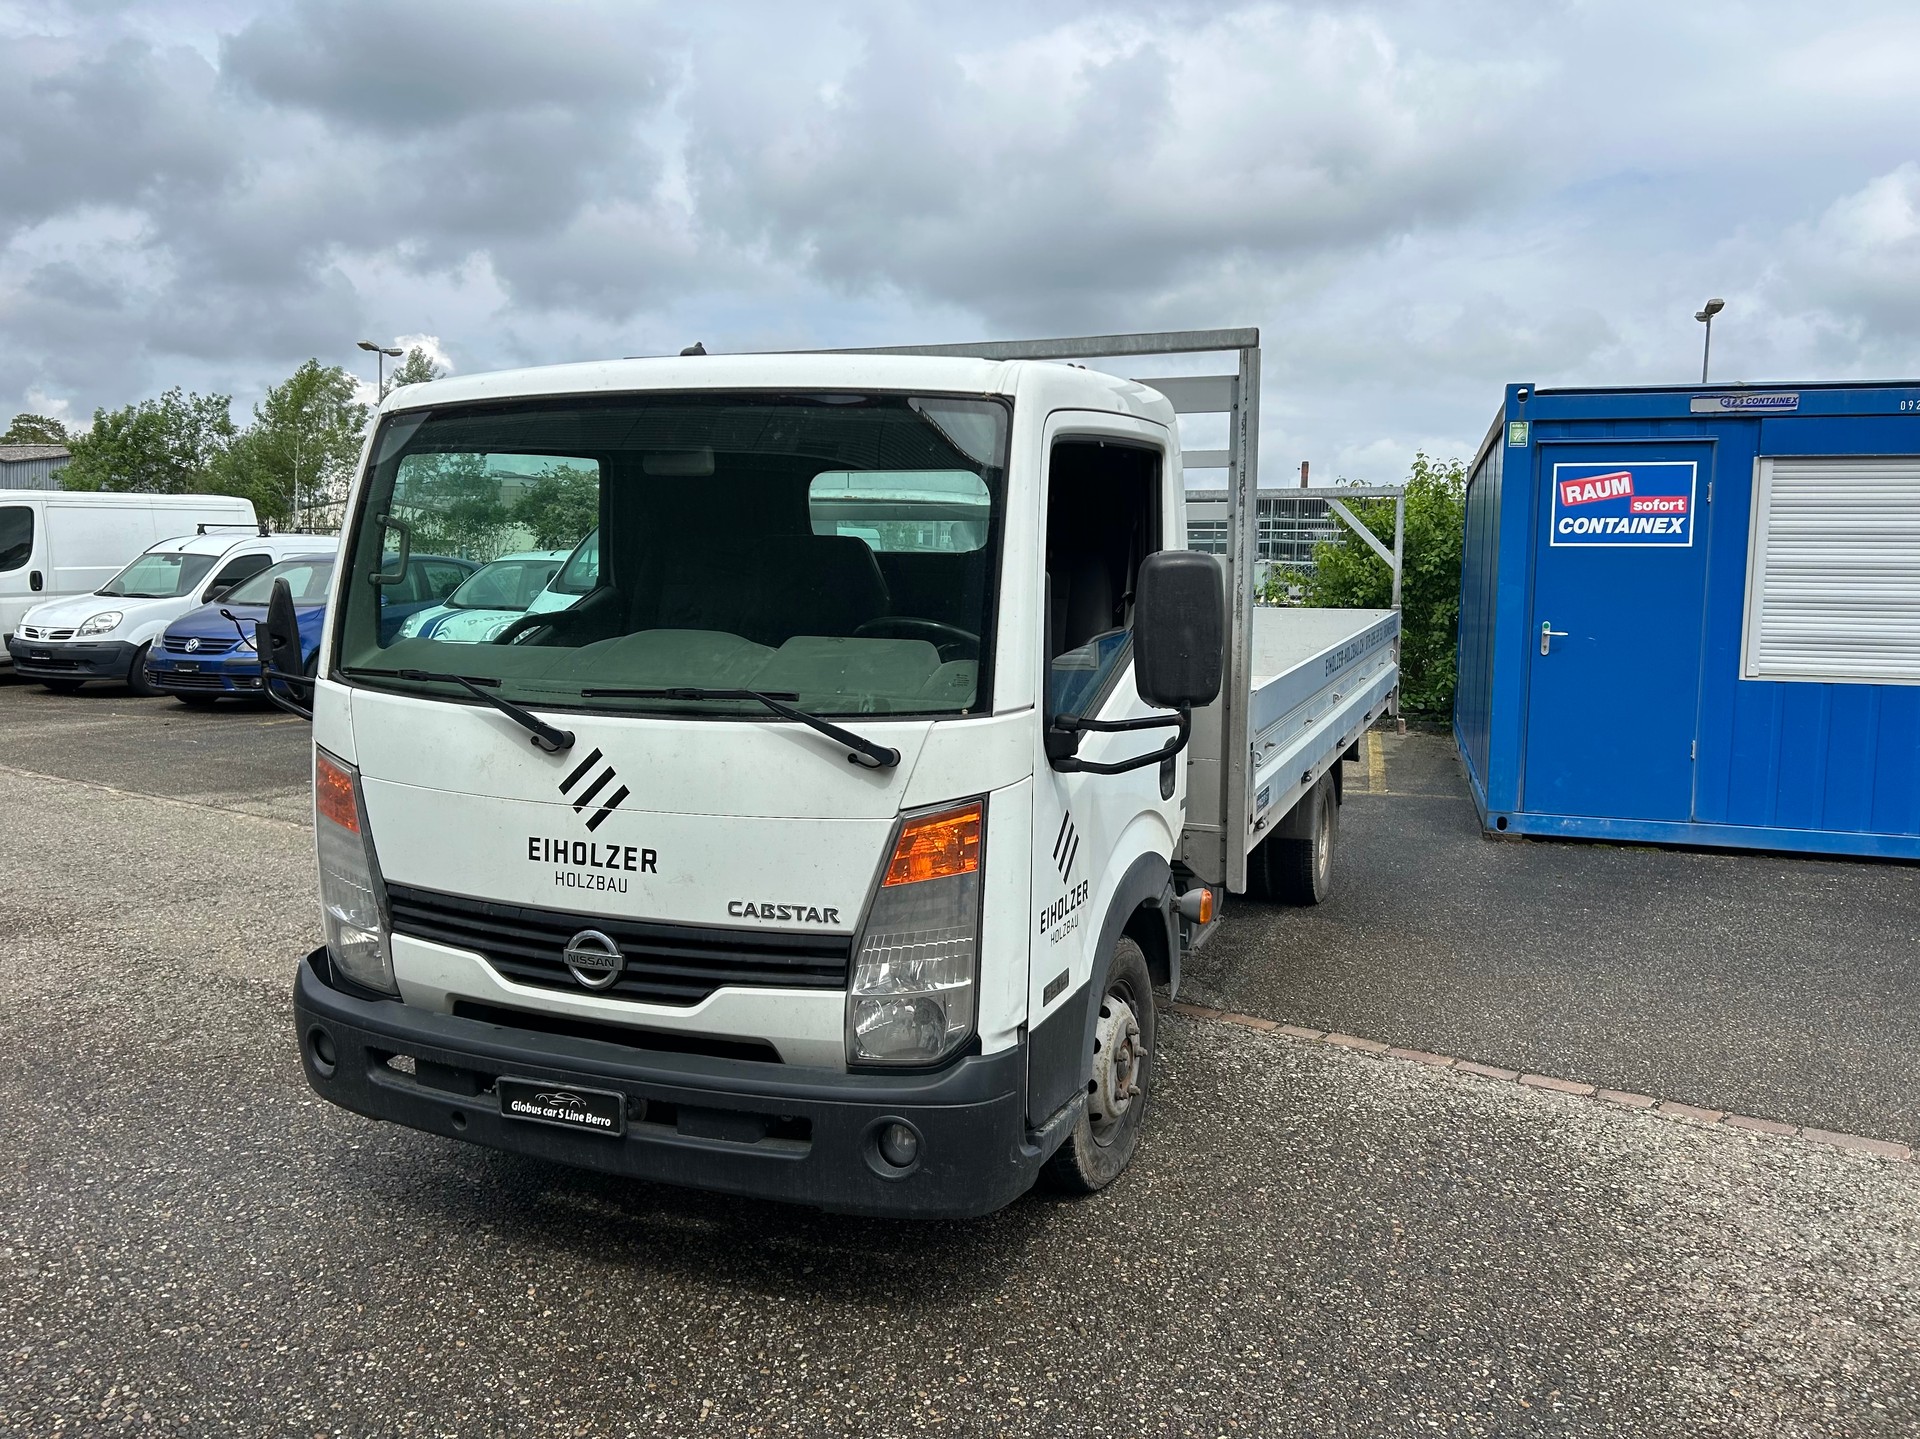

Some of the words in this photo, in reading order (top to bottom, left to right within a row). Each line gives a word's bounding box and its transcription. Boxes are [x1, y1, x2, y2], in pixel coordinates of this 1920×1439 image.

[1745, 396, 1799, 405] CONTAINEX
[1565, 477, 1631, 503] RAUM
[1633, 499, 1685, 511] sofort
[1558, 517, 1687, 534] CONTAINEX
[528, 836, 658, 874] EIHOLZER
[554, 871, 628, 893] HOLZBAU
[727, 900, 841, 924] CABSTAR
[1040, 879, 1089, 935] EIHOLZER
[1050, 914, 1079, 947] HOLZBAU
[567, 952, 615, 968] NISSAN
[511, 1100, 542, 1116] Globus
[542, 1107, 558, 1119] car
[557, 1108, 565, 1119] S
[564, 1110, 585, 1122] Line
[585, 1112, 612, 1127] Berro
